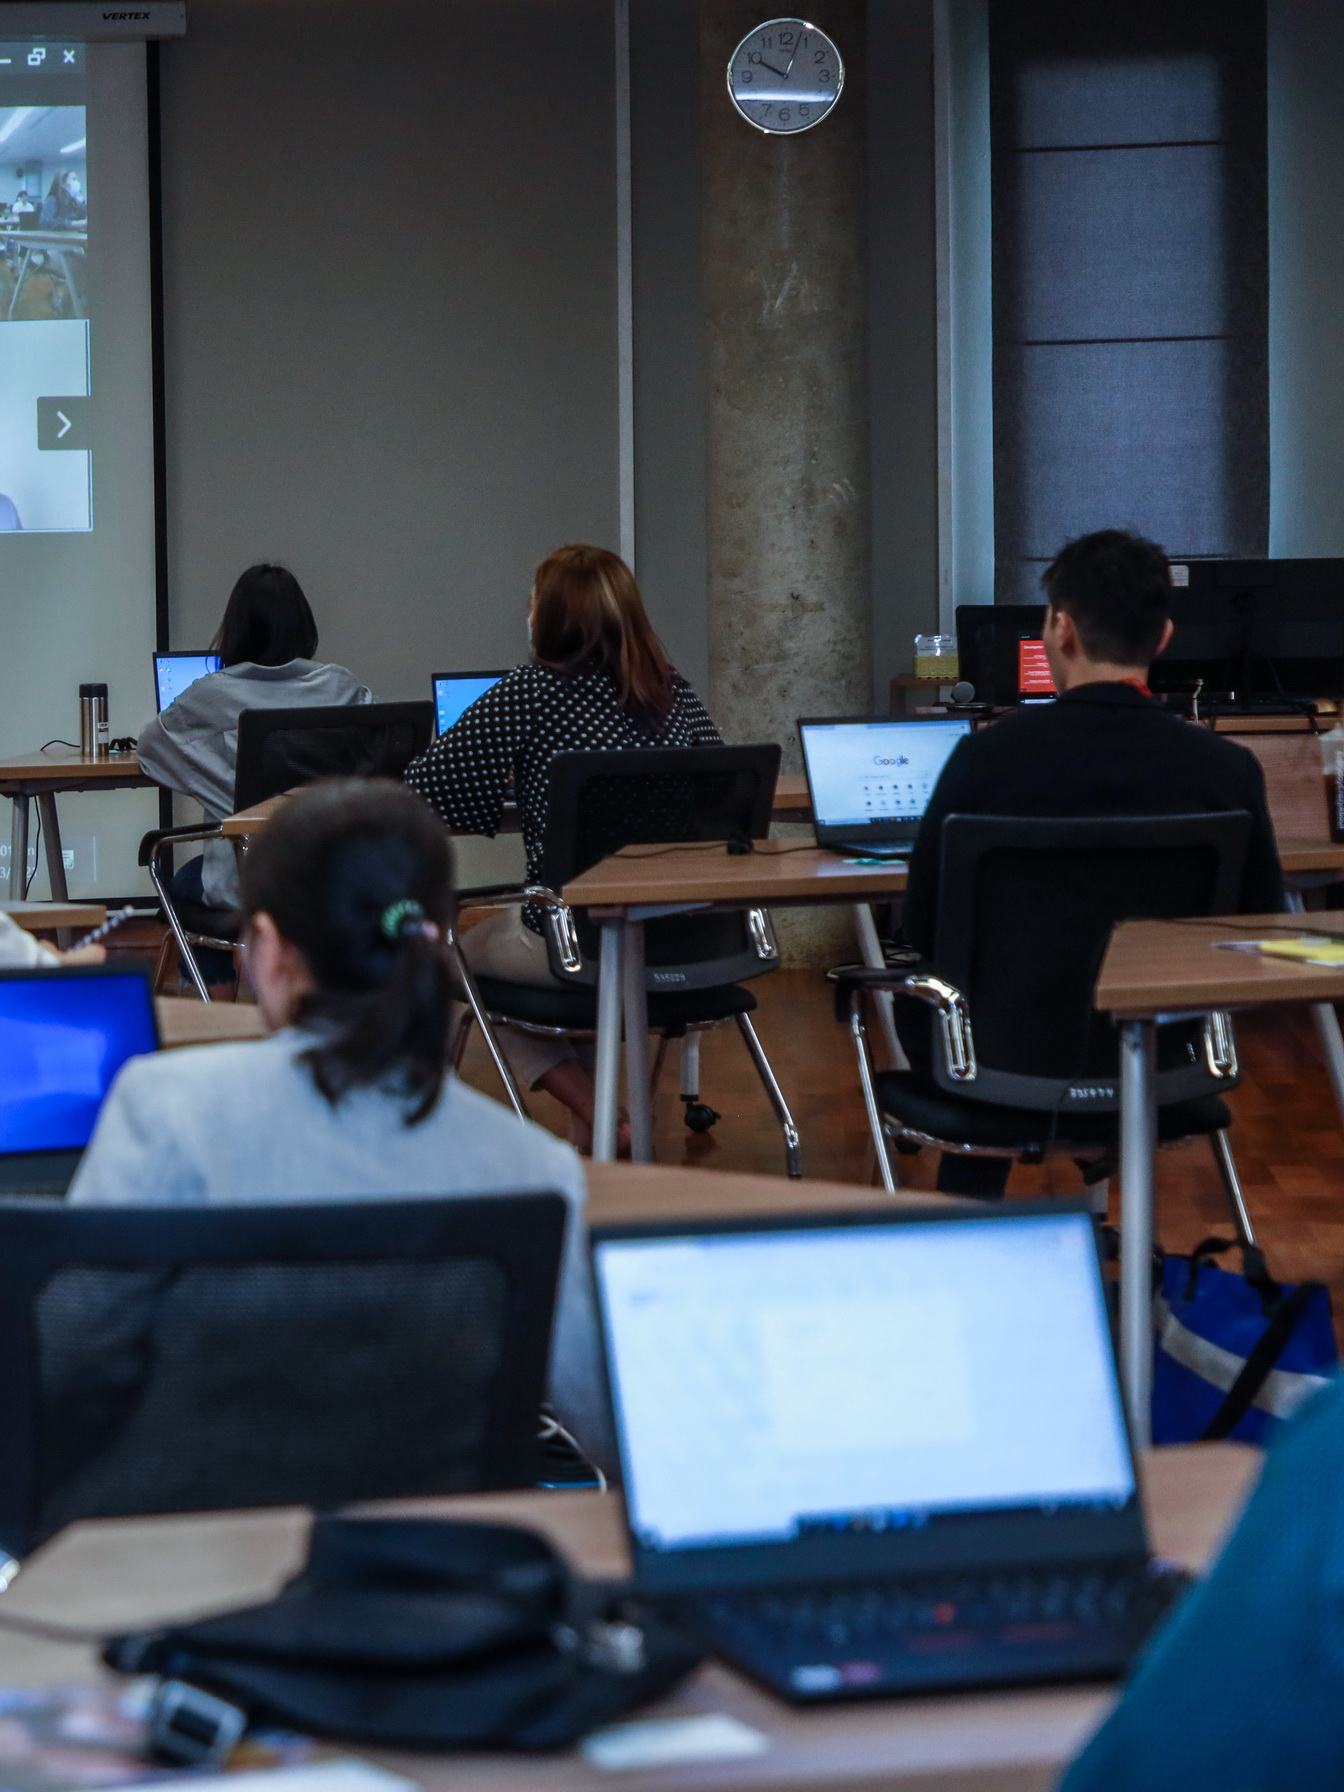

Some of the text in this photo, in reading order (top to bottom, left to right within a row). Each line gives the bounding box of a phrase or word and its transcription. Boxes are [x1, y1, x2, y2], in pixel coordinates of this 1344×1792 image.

[102, 12, 150, 20] VERTEX
[762, 37, 772, 48] 11
[779, 32, 793, 44] 12
[747, 52, 762, 64] 10
[815, 51, 824, 63] 2
[742, 71, 752, 83] 9
[819, 70, 830, 82] 3
[762, 104, 772, 116] 7
[779, 108, 790, 121] 6
[799, 104, 810, 116] 5
[874, 755, 909, 767] Google
